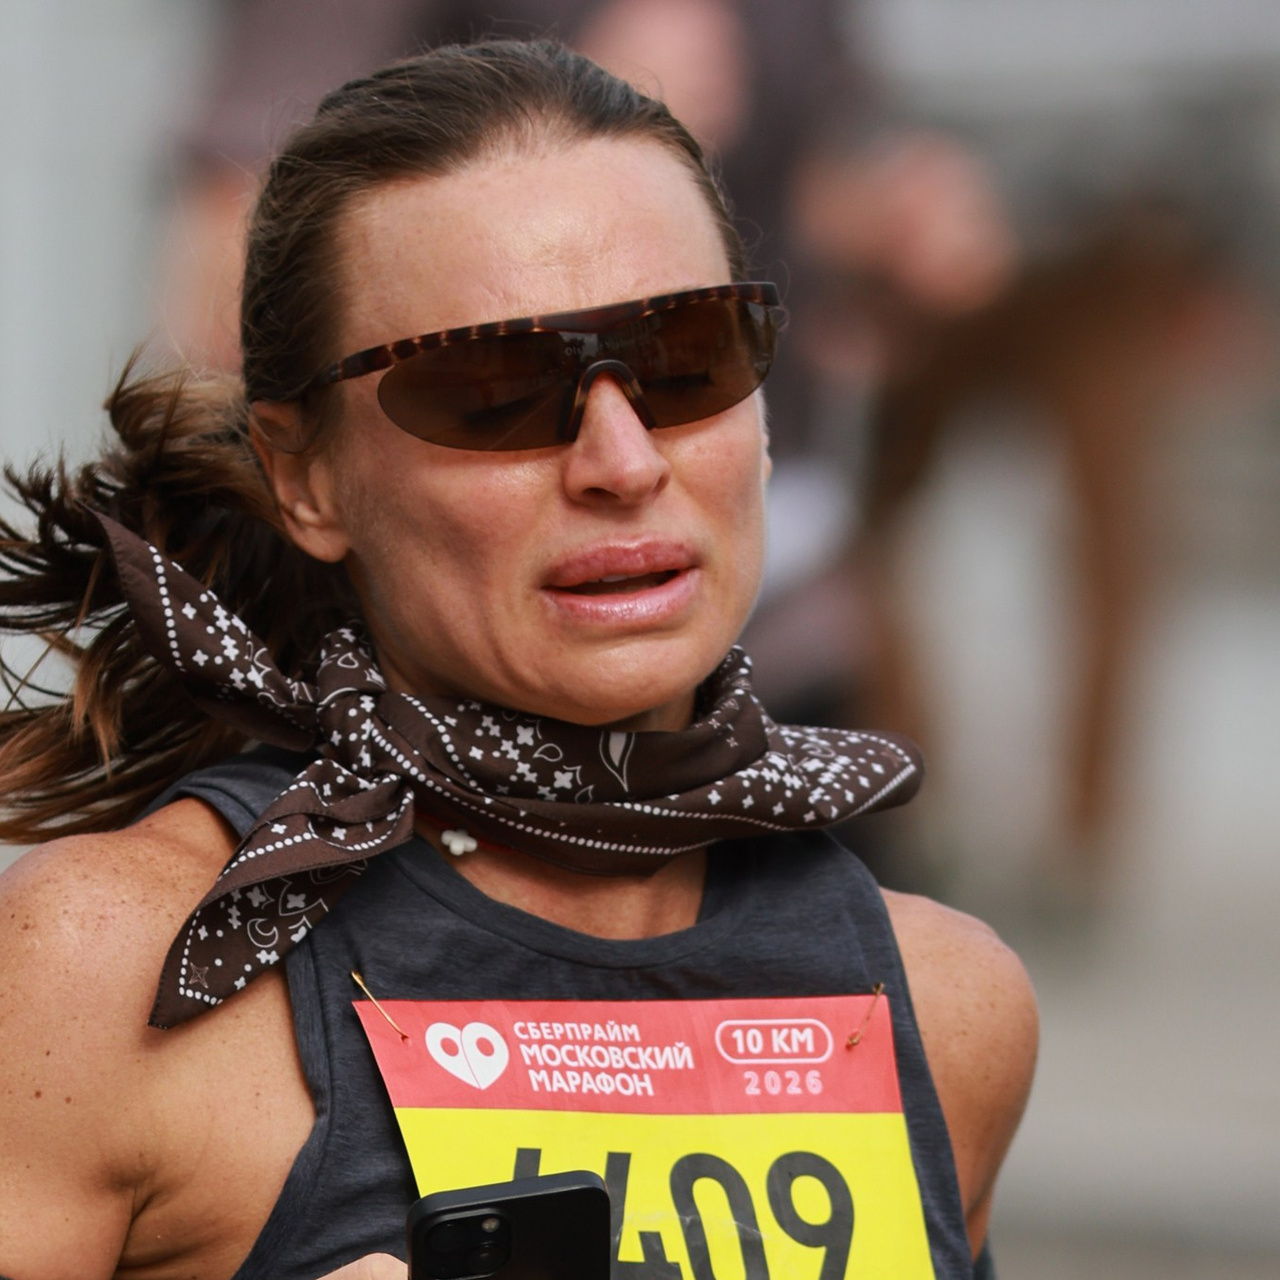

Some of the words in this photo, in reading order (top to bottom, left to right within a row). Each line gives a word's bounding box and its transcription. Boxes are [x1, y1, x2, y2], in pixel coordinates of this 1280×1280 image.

[513, 1020, 641, 1042] СБЕРПРАЙМ
[732, 1028, 763, 1054] 10
[519, 1041, 695, 1070] МОСКОВСКИЙ
[528, 1069, 655, 1096] МАРАФОН
[744, 1070, 823, 1095] 2026
